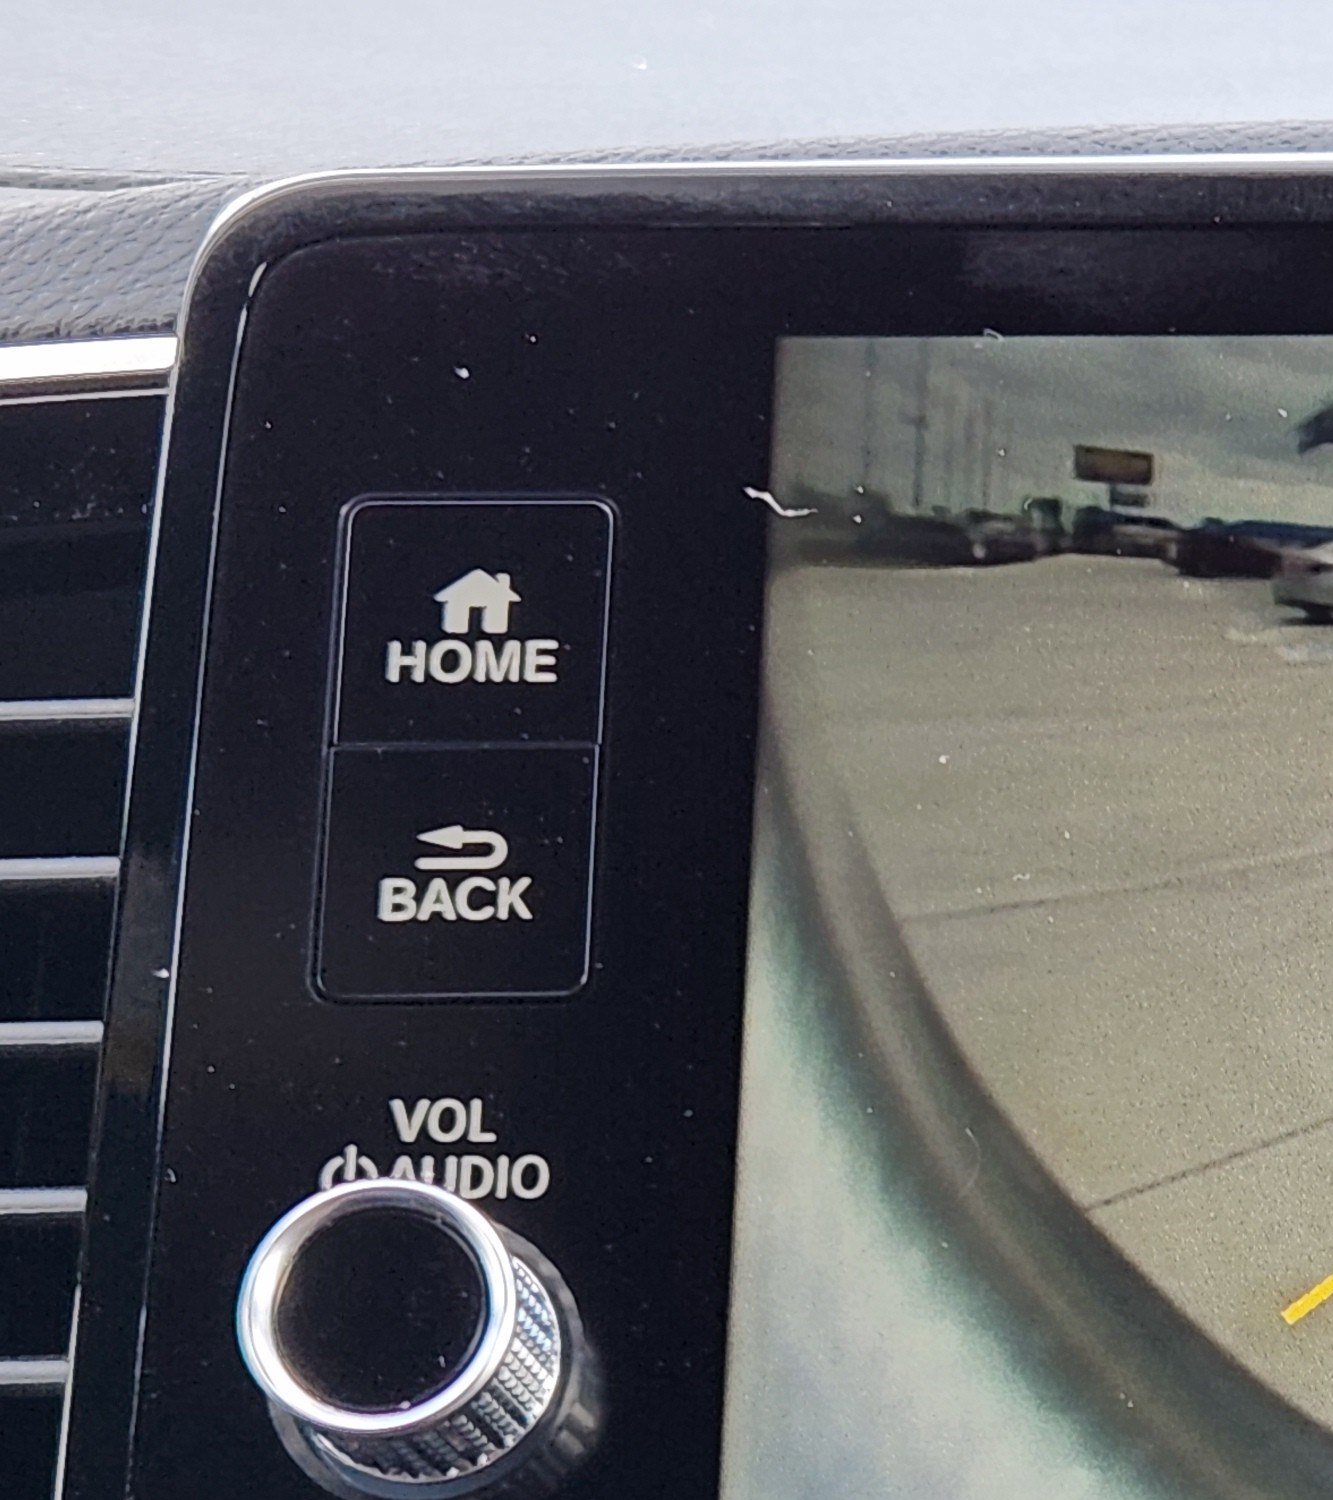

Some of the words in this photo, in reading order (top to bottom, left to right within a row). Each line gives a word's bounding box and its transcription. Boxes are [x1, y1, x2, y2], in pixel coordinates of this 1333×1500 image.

[385, 639, 559, 684] HOME
[377, 876, 533, 922] BACK
[388, 1097, 497, 1143] VOL
[389, 1154, 550, 1199] AUDIO
